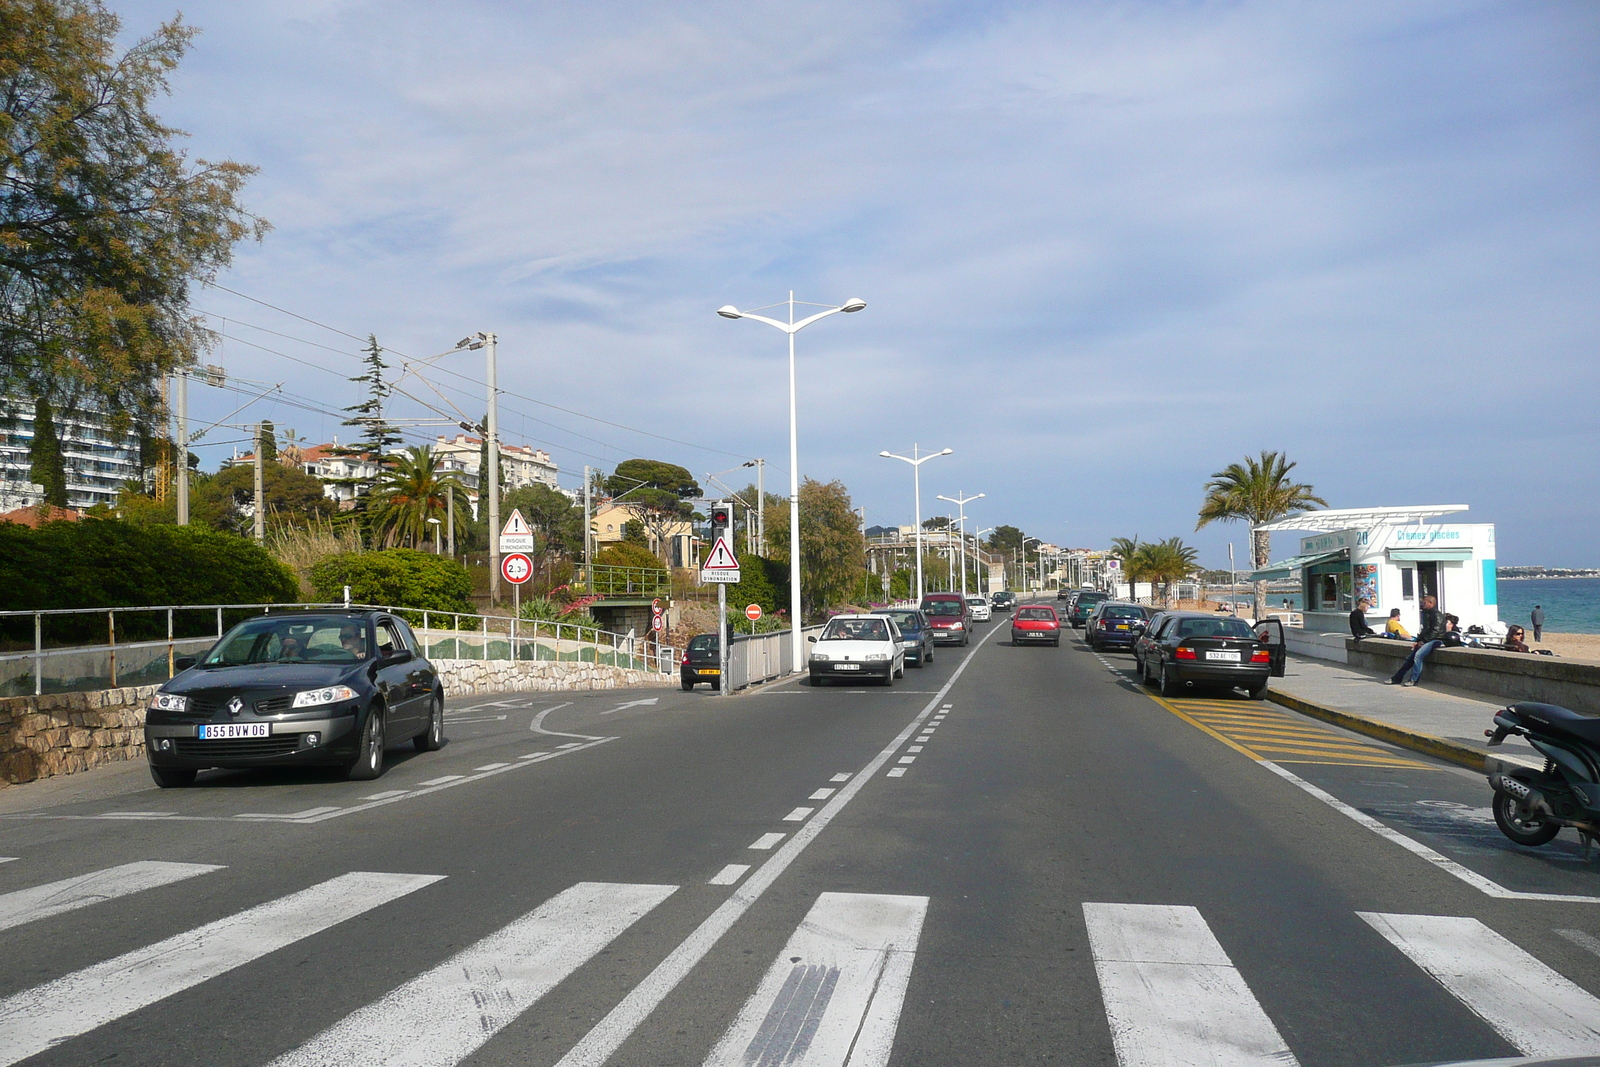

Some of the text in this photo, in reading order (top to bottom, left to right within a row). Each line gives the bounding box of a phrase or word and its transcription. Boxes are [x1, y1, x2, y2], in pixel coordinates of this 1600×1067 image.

[1356, 531, 1368, 545] 20
[1397, 529, 1460, 542] Crèmes glacées
[206, 724, 265, 738] 855 BVW 06
